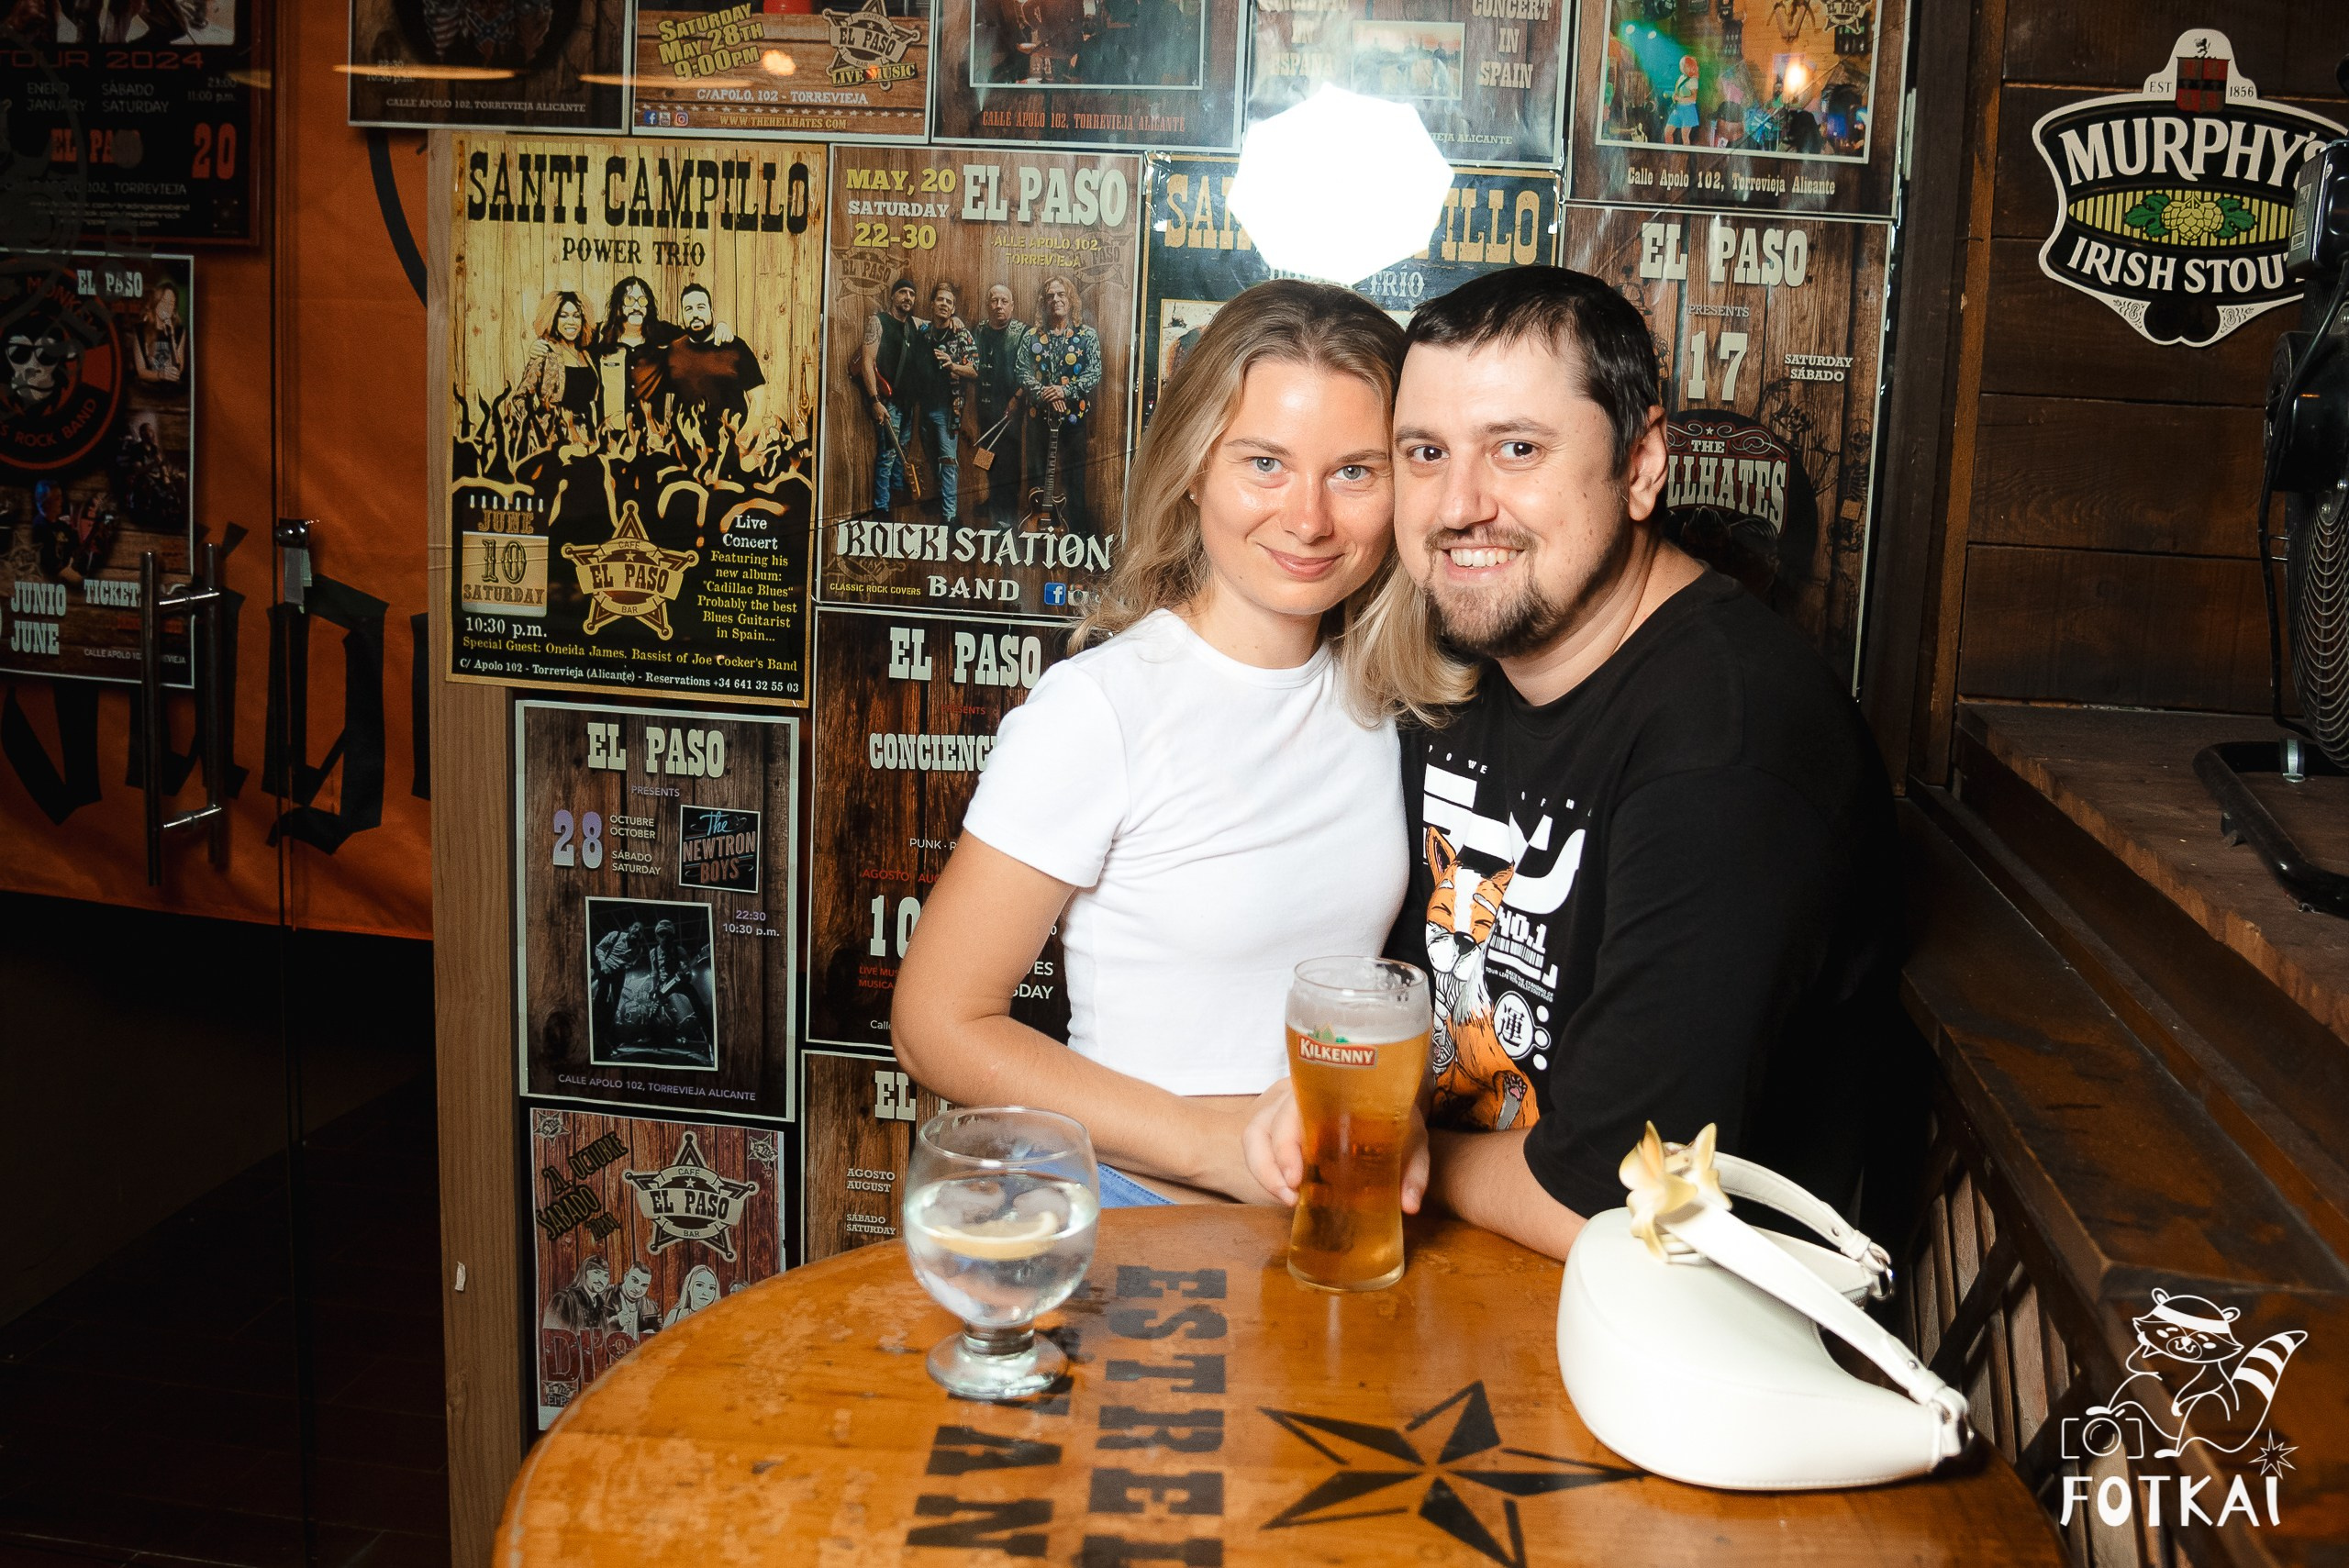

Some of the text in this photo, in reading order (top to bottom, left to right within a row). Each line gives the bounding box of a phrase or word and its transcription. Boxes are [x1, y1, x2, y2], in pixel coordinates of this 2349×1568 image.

[1472, 0, 1552, 21] CONCERT
[658, 3, 752, 42] SATURDAY
[839, 28, 896, 56] EL PASO
[1497, 28, 1520, 53] IN
[106, 50, 204, 70] 2024
[831, 64, 916, 85] LIVE MUSIC
[1477, 61, 1534, 89] SPAIN
[758, 91, 869, 105] 102 TORREVIEJA
[2149, 81, 2255, 99] EST 1856
[101, 99, 170, 115] SATURDAY
[386, 98, 586, 113] CALLE APOLO TORREVIEJA ALICANTE
[982, 109, 1186, 133] CALLE APOLO TORREVIEJA ALICANTE
[50, 128, 78, 162] EL
[1457, 134, 1514, 146] ALICANTE
[191, 122, 238, 181] 20
[846, 168, 957, 196] MAY, 20
[1626, 167, 1836, 195] Calle Apolo 102, Torrevieja Alicante
[467, 150, 810, 235] SANTI CAMPILLO
[961, 164, 1130, 228] EL PASO
[848, 200, 951, 219] SATURDAY
[853, 222, 938, 250] 22-30
[1029, 236, 1071, 250] APOLO
[562, 234, 707, 267] POWER TRÍO
[1639, 222, 1808, 287] EL PASO
[2066, 236, 2177, 293] IRISH
[76, 269, 144, 299] EL PASO
[1687, 304, 1750, 318] PRESENTS
[1687, 330, 1749, 402] 17
[1784, 353, 1854, 368] SATURDAY
[1790, 367, 1845, 383] SÁBADO
[61, 397, 98, 440] BAND
[14, 428, 58, 448] ROCK
[1690, 439, 1726, 453] THE
[478, 509, 535, 535] JUNE
[735, 514, 768, 530] Live
[722, 533, 779, 550] Concert
[837, 519, 950, 562] ROCK
[482, 538, 528, 584] 10
[710, 550, 789, 568] Featuring his
[590, 563, 670, 595] EL PASO
[716, 567, 783, 582] new album:
[10, 580, 67, 617] JUNIO
[462, 584, 546, 605] SATURDAY
[829, 583, 922, 596] CLASSIC ROCK COVERS
[926, 575, 1021, 601] BAND
[621, 606, 639, 614] BAR
[697, 595, 798, 614] Probably the best
[466, 617, 548, 639] 10:30 p.m.
[702, 610, 791, 628] Blues Guitarist
[10, 619, 61, 655] JUNE
[717, 628, 776, 643] in Spain...
[84, 648, 131, 661] CALLE APOLO
[462, 637, 503, 650] Special
[506, 639, 541, 653] Guest:
[545, 643, 585, 656] Oneida
[631, 649, 673, 662] Bassist
[676, 652, 688, 663] of
[692, 652, 713, 666] Joe
[717, 655, 763, 670] Cocker's
[767, 657, 797, 672] Band
[888, 626, 1042, 690] EL PASO
[473, 660, 800, 694] Apolo 102 Torrevieja (Alicante) Reservations +34 641 32 55 03
[940, 703, 987, 716] PRESENTS
[586, 721, 726, 779] EL PASO
[630, 784, 681, 798] PRESENTS
[609, 814, 655, 828] OCTUBRE
[552, 808, 604, 869] 28
[609, 826, 656, 840] OCTOBER
[908, 837, 942, 850] PUNK
[611, 850, 653, 863] SÁBADO
[682, 830, 757, 863] NEWTRON
[611, 862, 662, 876] SATURDAY
[700, 857, 740, 884] BOYS
[862, 868, 910, 883] AGOSTO
[735, 909, 767, 922] 22:30
[722, 922, 781, 937] 10:30 p.m.
[870, 895, 921, 960] 10
[859, 965, 878, 976] LIVE
[1496, 1004, 1527, 1050] 運
[1299, 1037, 1375, 1064] KILKENNY
[558, 1073, 757, 1102] CALLE APOLO TORREVIEJA ALICANTE
[874, 1069, 917, 1121] EL
[846, 1167, 896, 1182] AGOSTO
[846, 1180, 892, 1194] AUGUST
[649, 1189, 730, 1220] EL PASO
[846, 1211, 886, 1225] SÁBADO
[683, 1229, 701, 1239] BAR
[846, 1223, 897, 1236] SATURDAY
